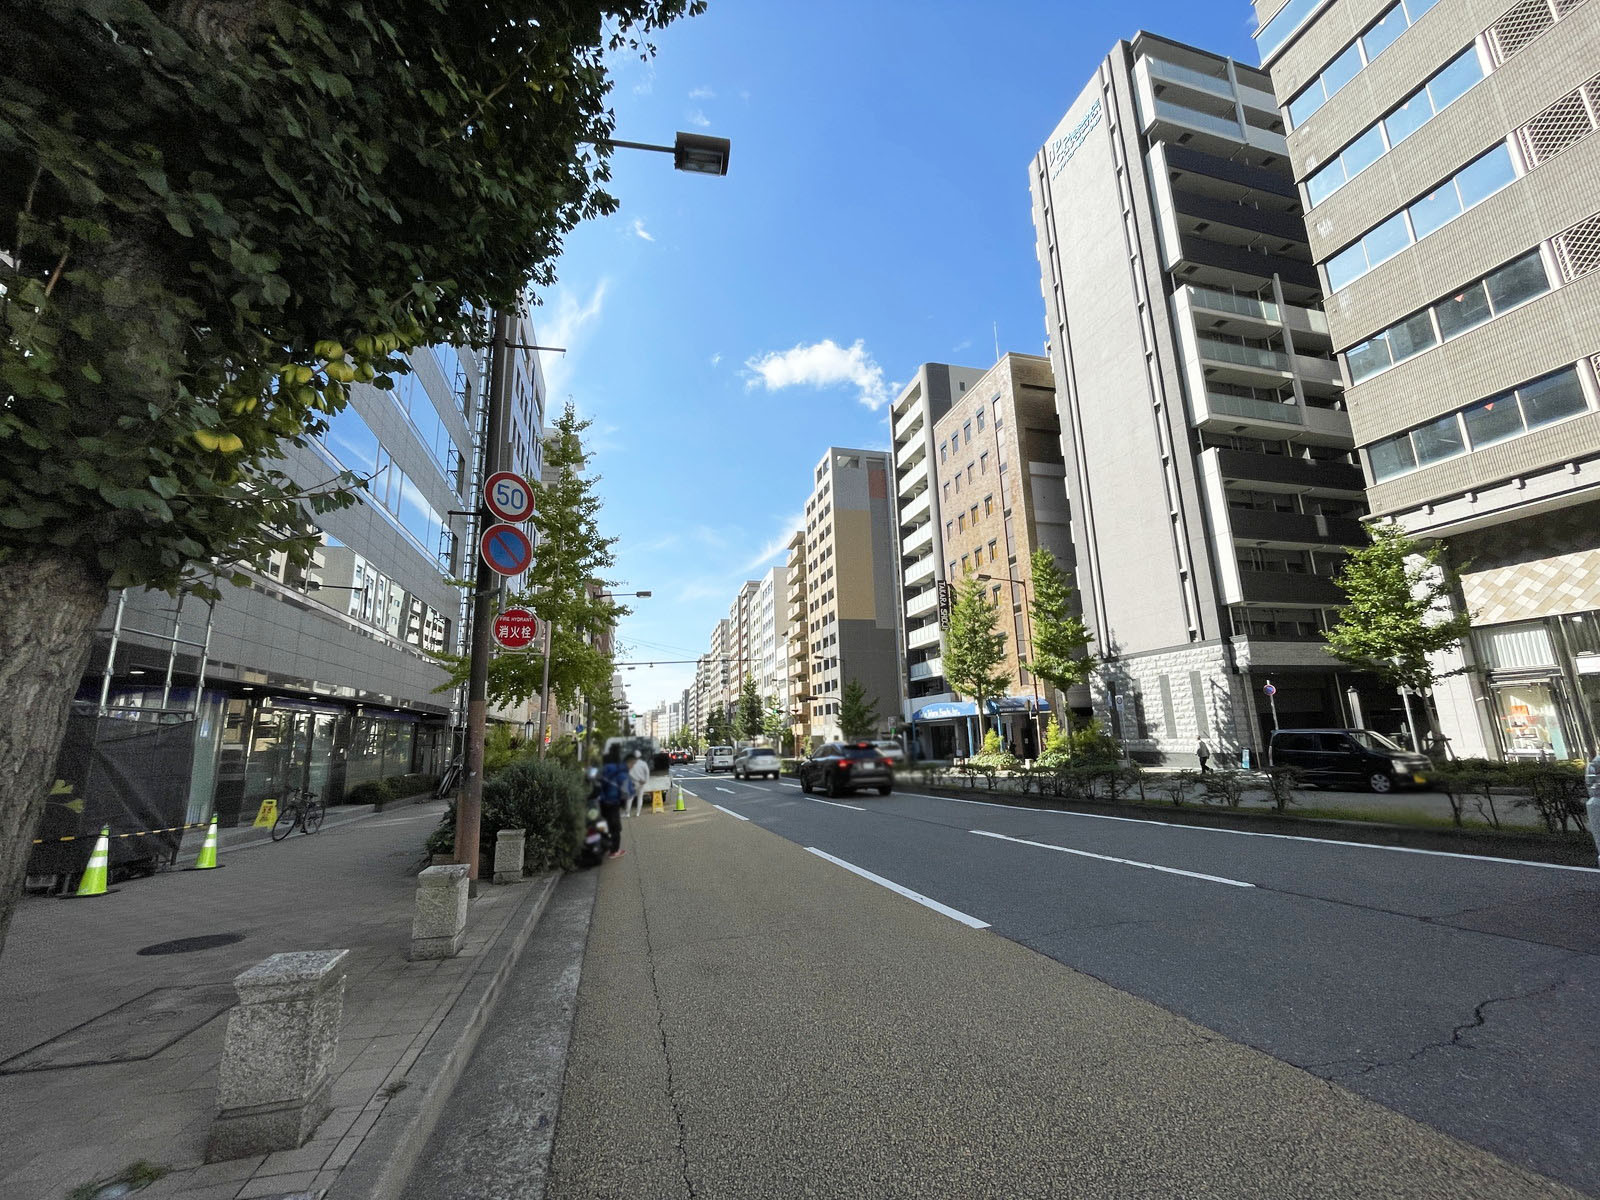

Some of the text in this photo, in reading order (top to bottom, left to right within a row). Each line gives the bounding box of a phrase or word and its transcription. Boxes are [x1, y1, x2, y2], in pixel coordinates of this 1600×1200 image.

[496, 483, 524, 510] 50
[938, 581, 948, 607] TAKARA
[498, 625, 532, 639] 消火栓
